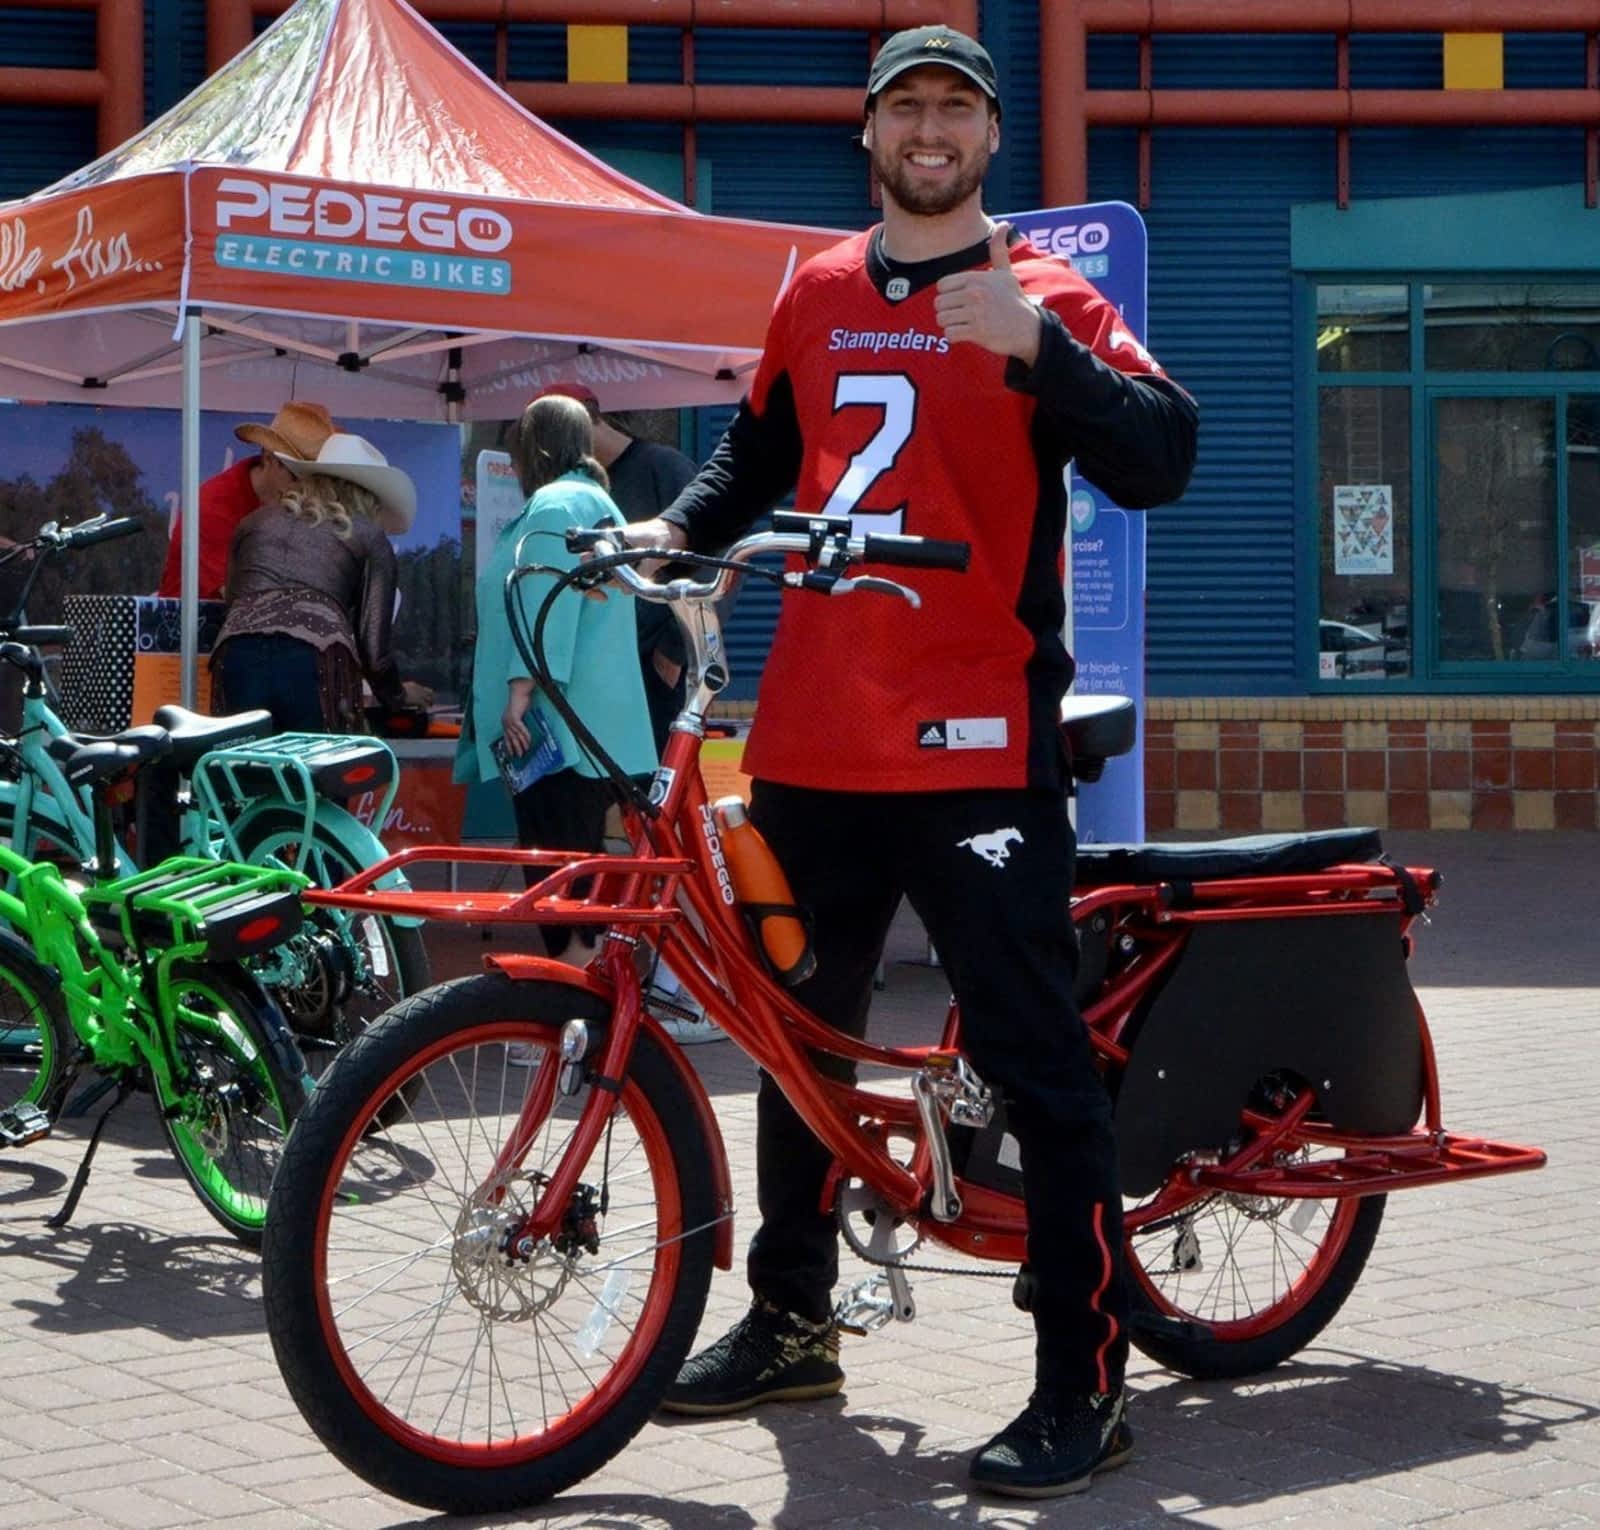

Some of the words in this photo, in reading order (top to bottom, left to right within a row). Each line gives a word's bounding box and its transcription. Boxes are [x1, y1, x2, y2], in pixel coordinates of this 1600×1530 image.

[216, 178, 513, 253] PEDEGO
[1019, 222, 1110, 254] EGO
[0, 217, 45, 295] llo,
[52, 205, 163, 291] fun...
[221, 241, 392, 276] ELECTRIC
[410, 258, 505, 288] BIKES
[1074, 257, 1106, 274] KES
[828, 327, 950, 354] Stampeders
[821, 371, 918, 538] 2
[956, 728, 967, 740] L
[698, 803, 735, 906] PEDEGO
